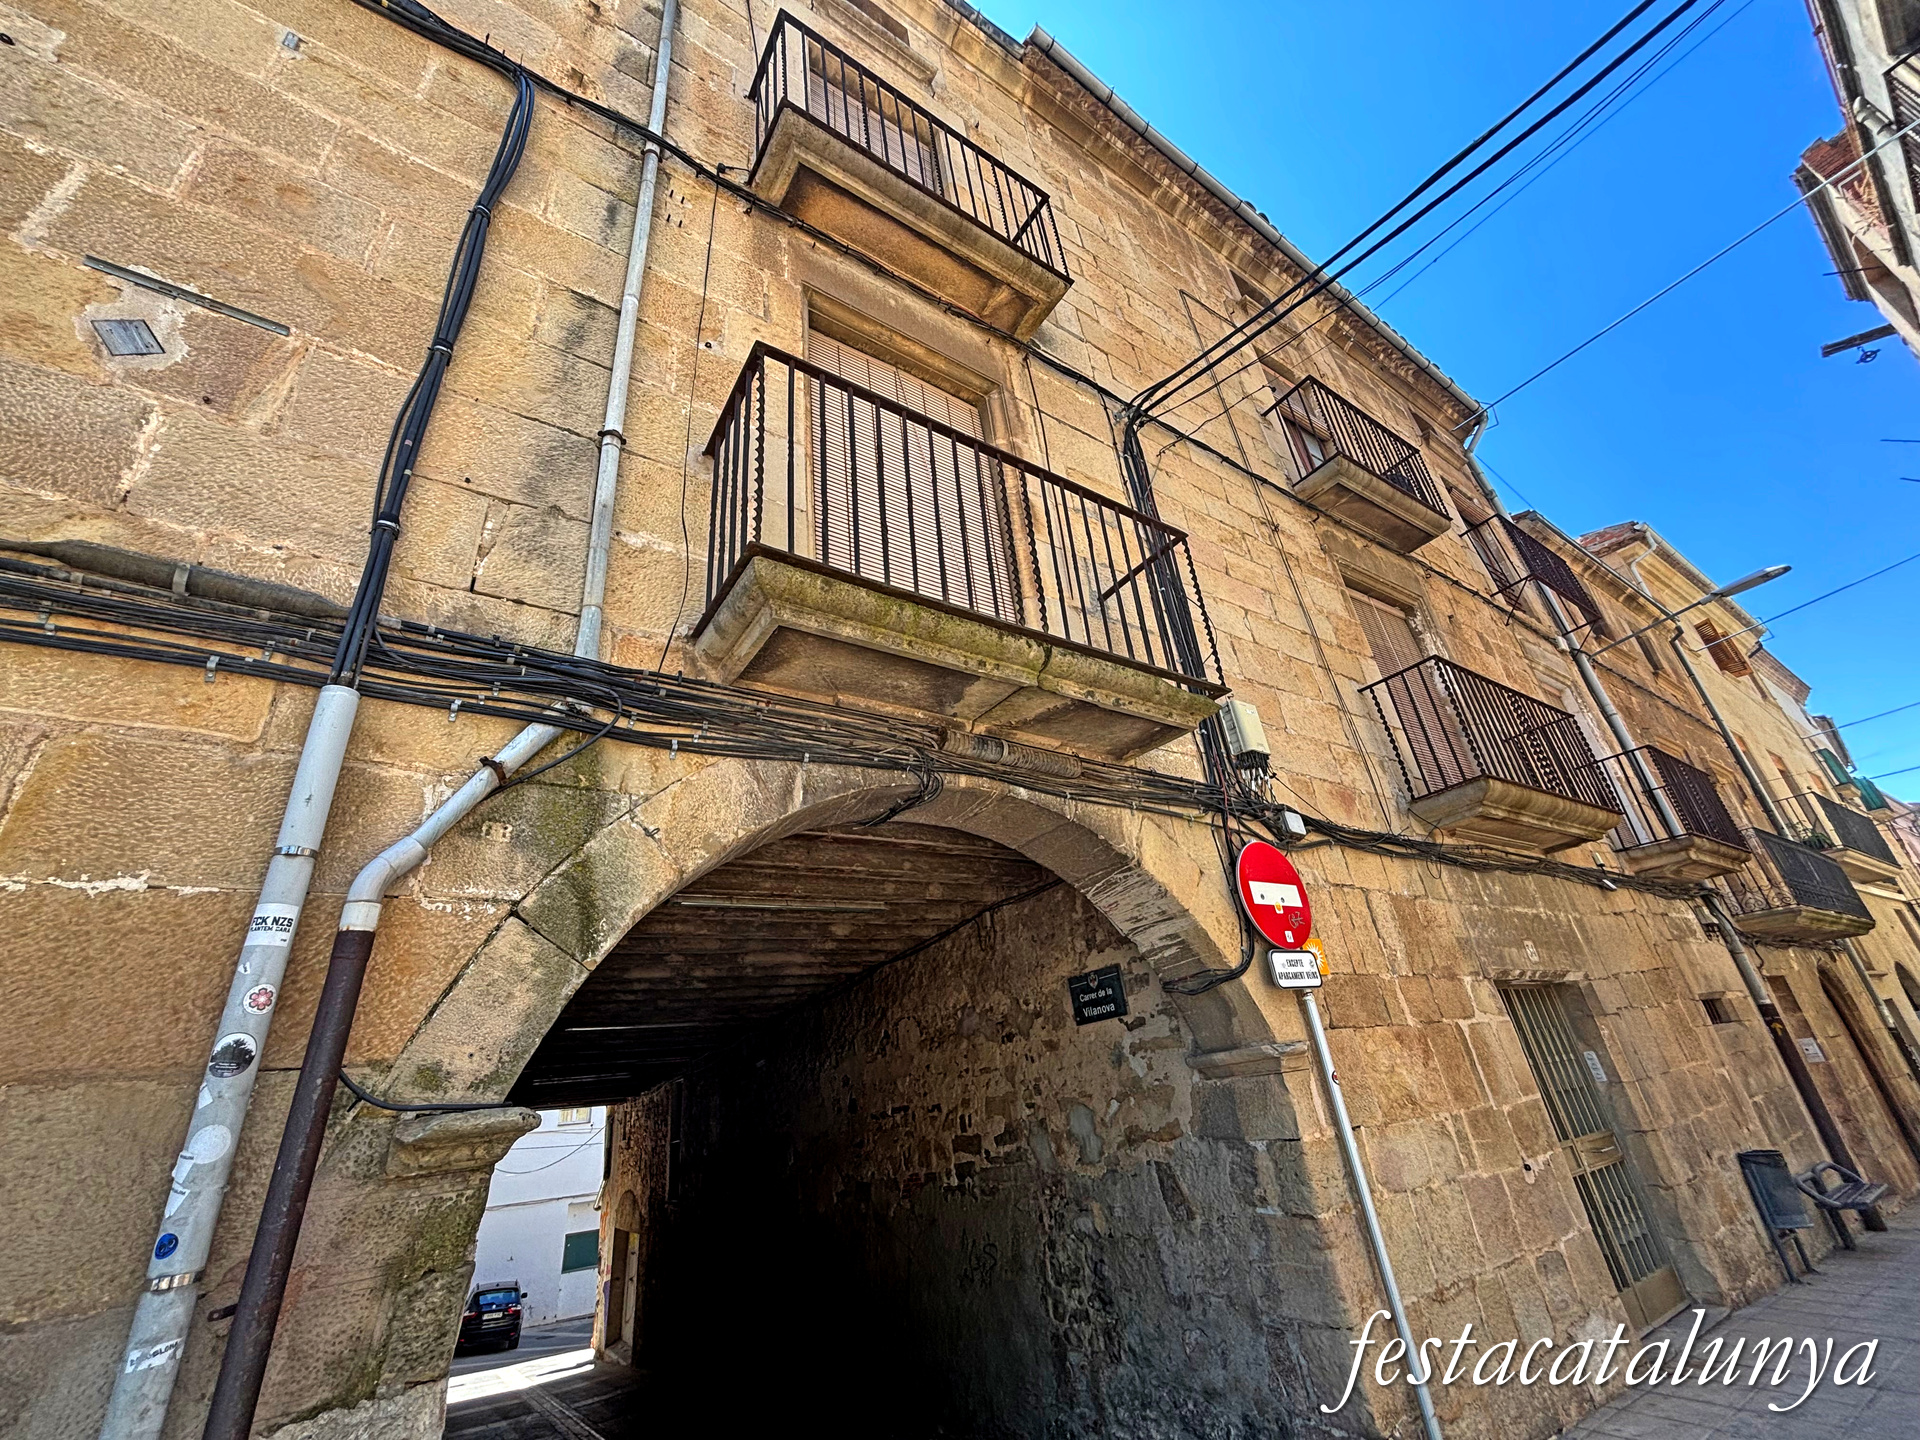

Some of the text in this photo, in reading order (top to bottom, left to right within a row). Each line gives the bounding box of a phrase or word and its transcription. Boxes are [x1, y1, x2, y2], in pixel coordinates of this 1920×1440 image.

[251, 916, 293, 927] FCK NZS
[1286, 959, 1304, 967] EXCEPTE
[1278, 971, 1305, 980] APARCAMENT
[1080, 987, 1113, 1002] Carrer de la
[1083, 1003, 1116, 1017] Vilanova
